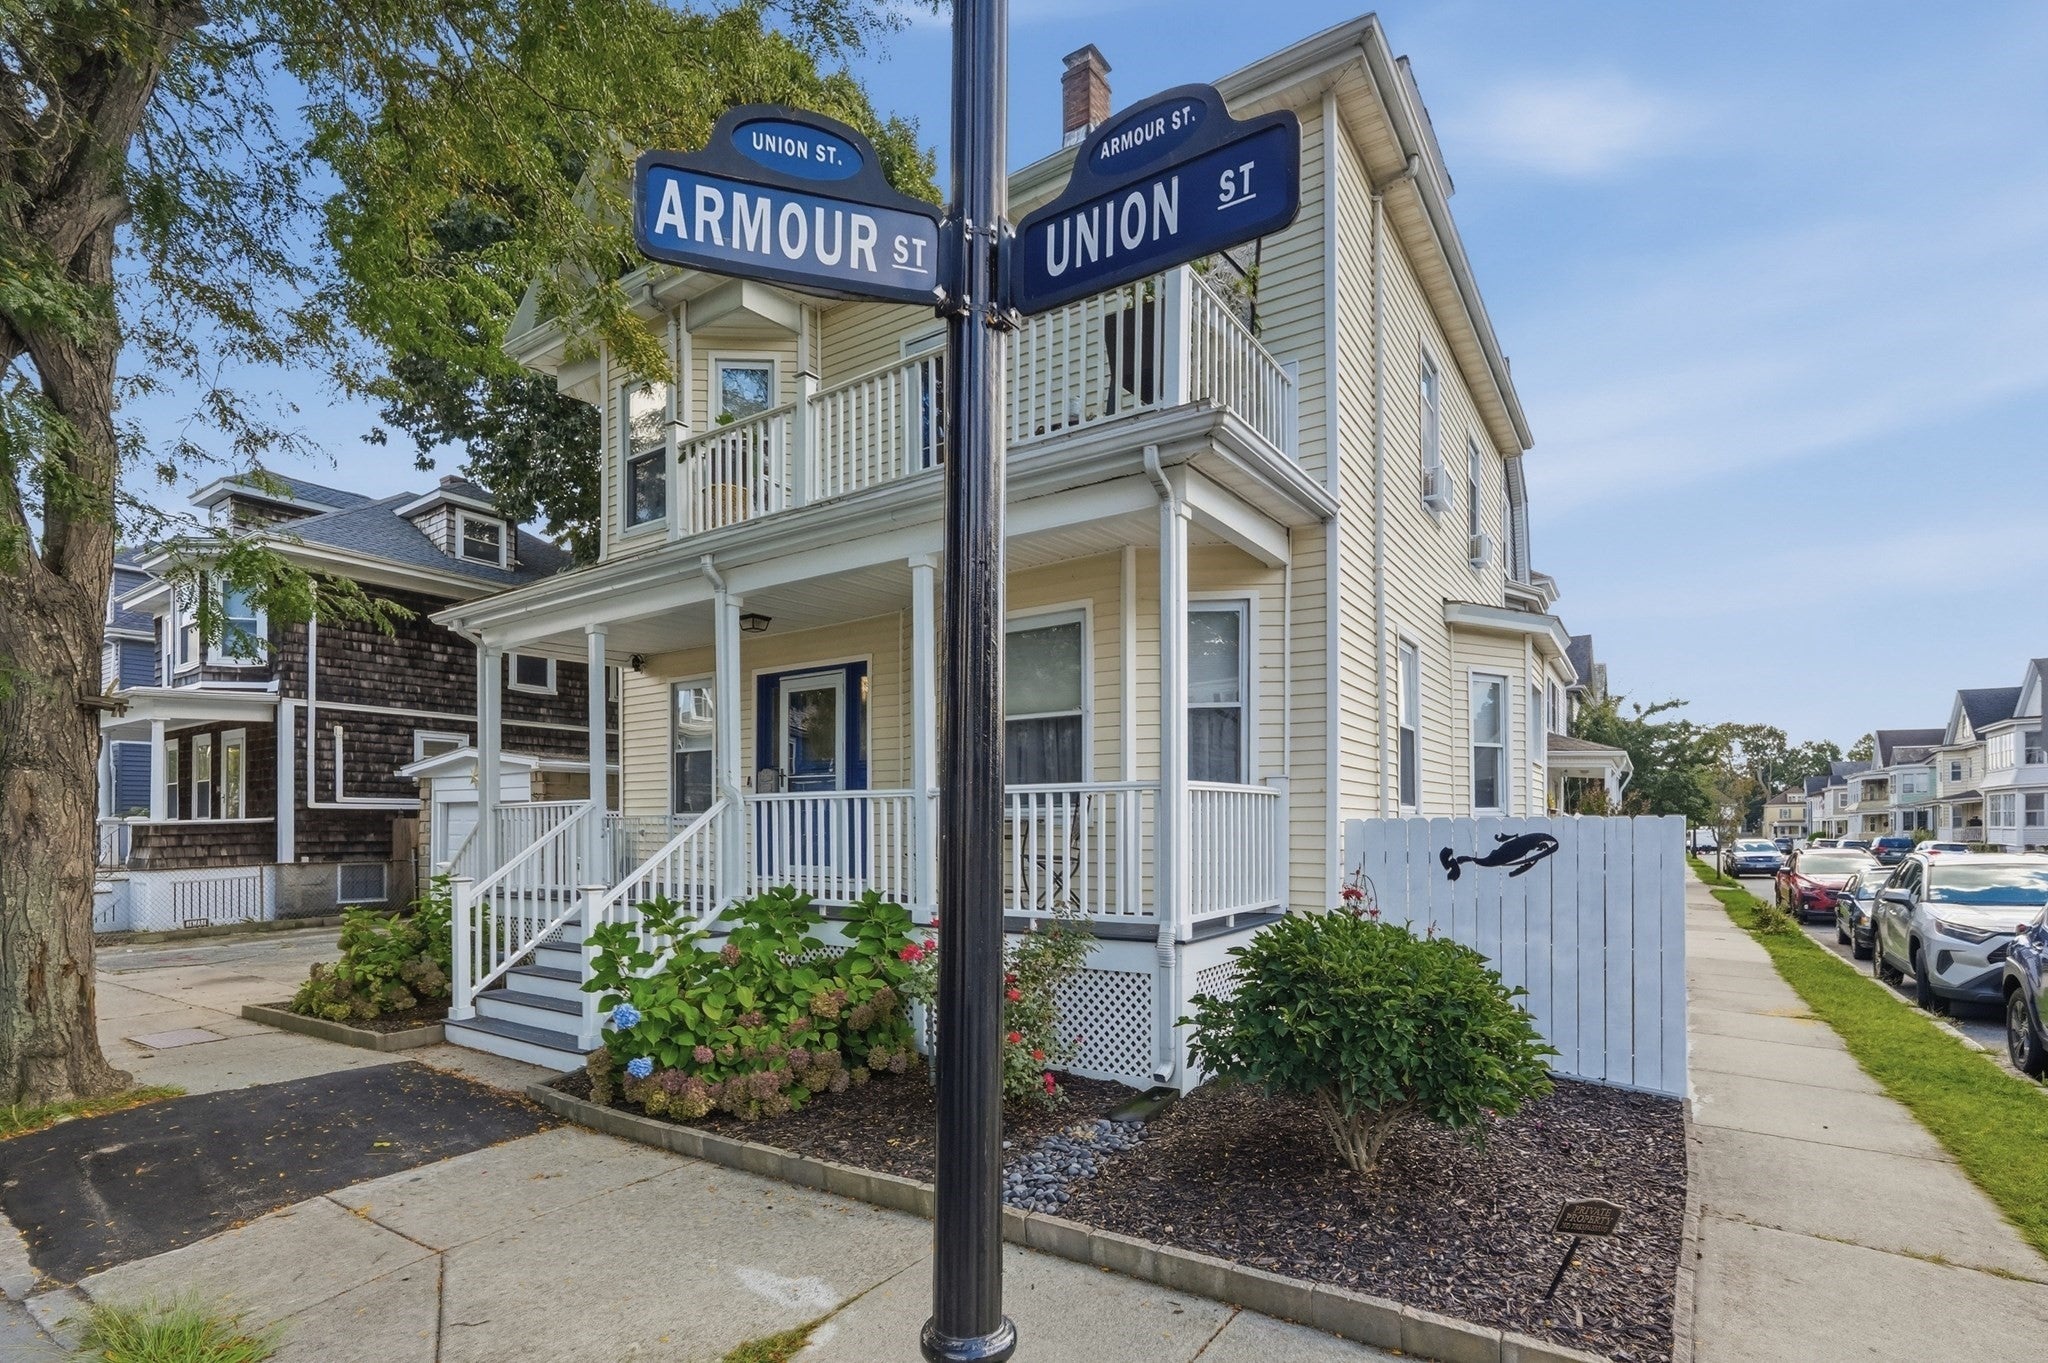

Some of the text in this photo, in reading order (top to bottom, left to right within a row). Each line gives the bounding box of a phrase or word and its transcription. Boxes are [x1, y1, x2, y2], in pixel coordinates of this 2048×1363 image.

[752, 131, 842, 166] UNION ST.
[1100, 106, 1196, 160] ARMOUR ST.
[654, 178, 927, 273] ARMOUR ST
[1046, 161, 1255, 277] UNION ST
[1565, 1213, 1614, 1225] PROPERTY
[1573, 1205, 1612, 1217] PRIVATE
